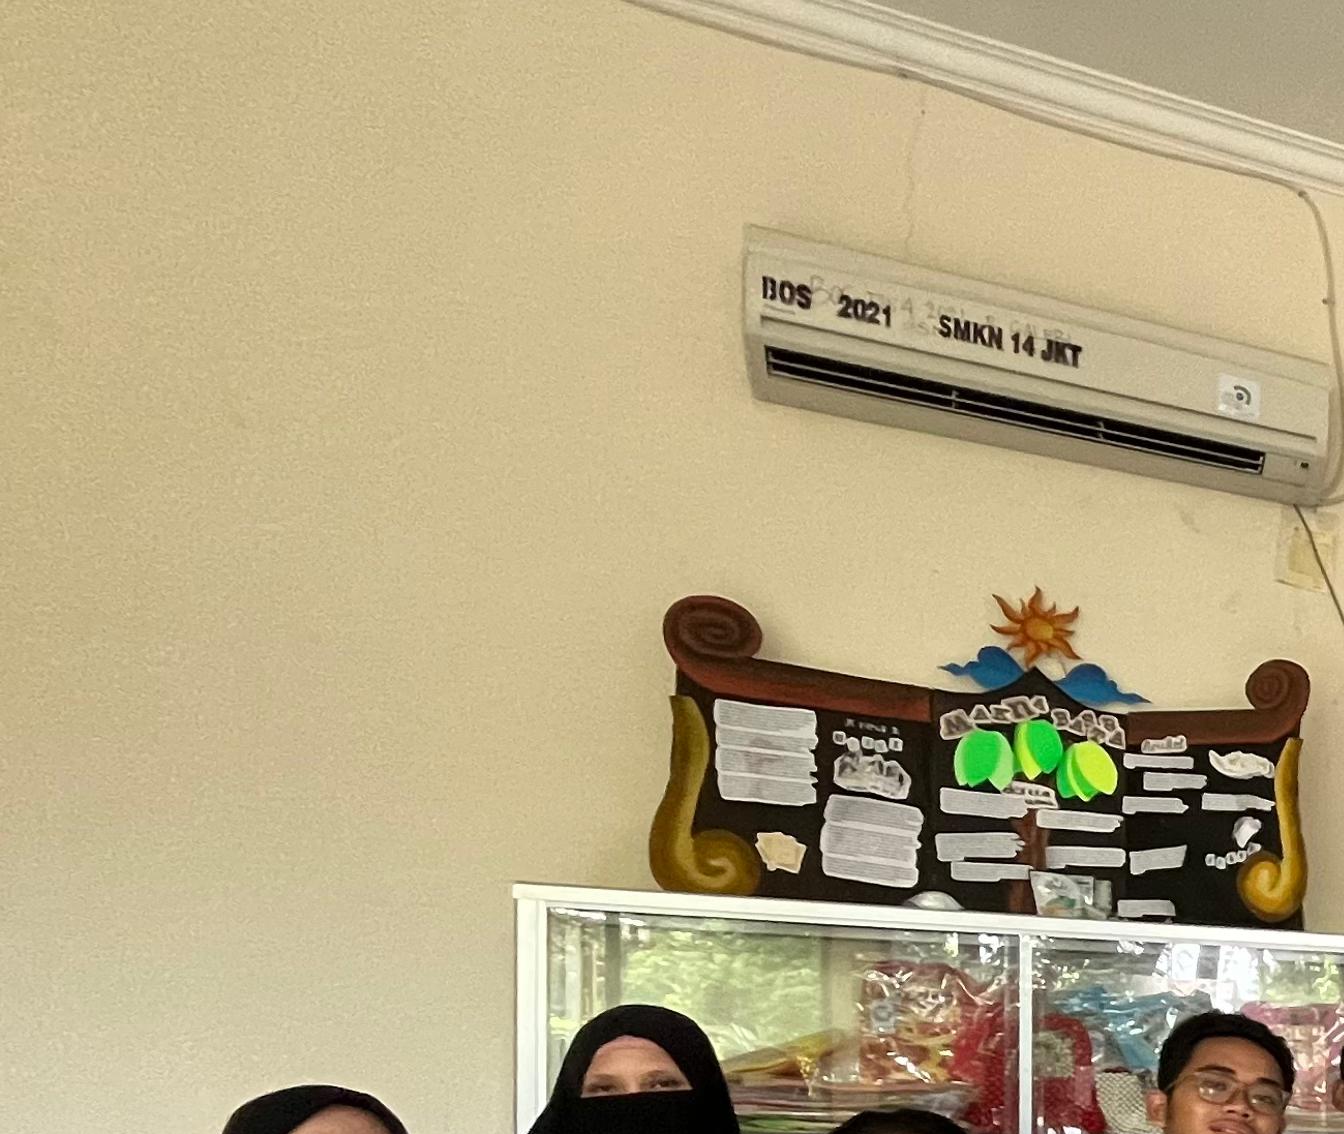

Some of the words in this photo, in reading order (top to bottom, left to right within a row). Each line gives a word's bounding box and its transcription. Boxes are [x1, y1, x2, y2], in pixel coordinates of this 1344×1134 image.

[762, 275, 812, 310] BOS
[838, 294, 891, 328] 2021
[938, 314, 1004, 350] SMKN
[1011, 332, 1035, 357] 14
[1041, 338, 1083, 368] JKT
